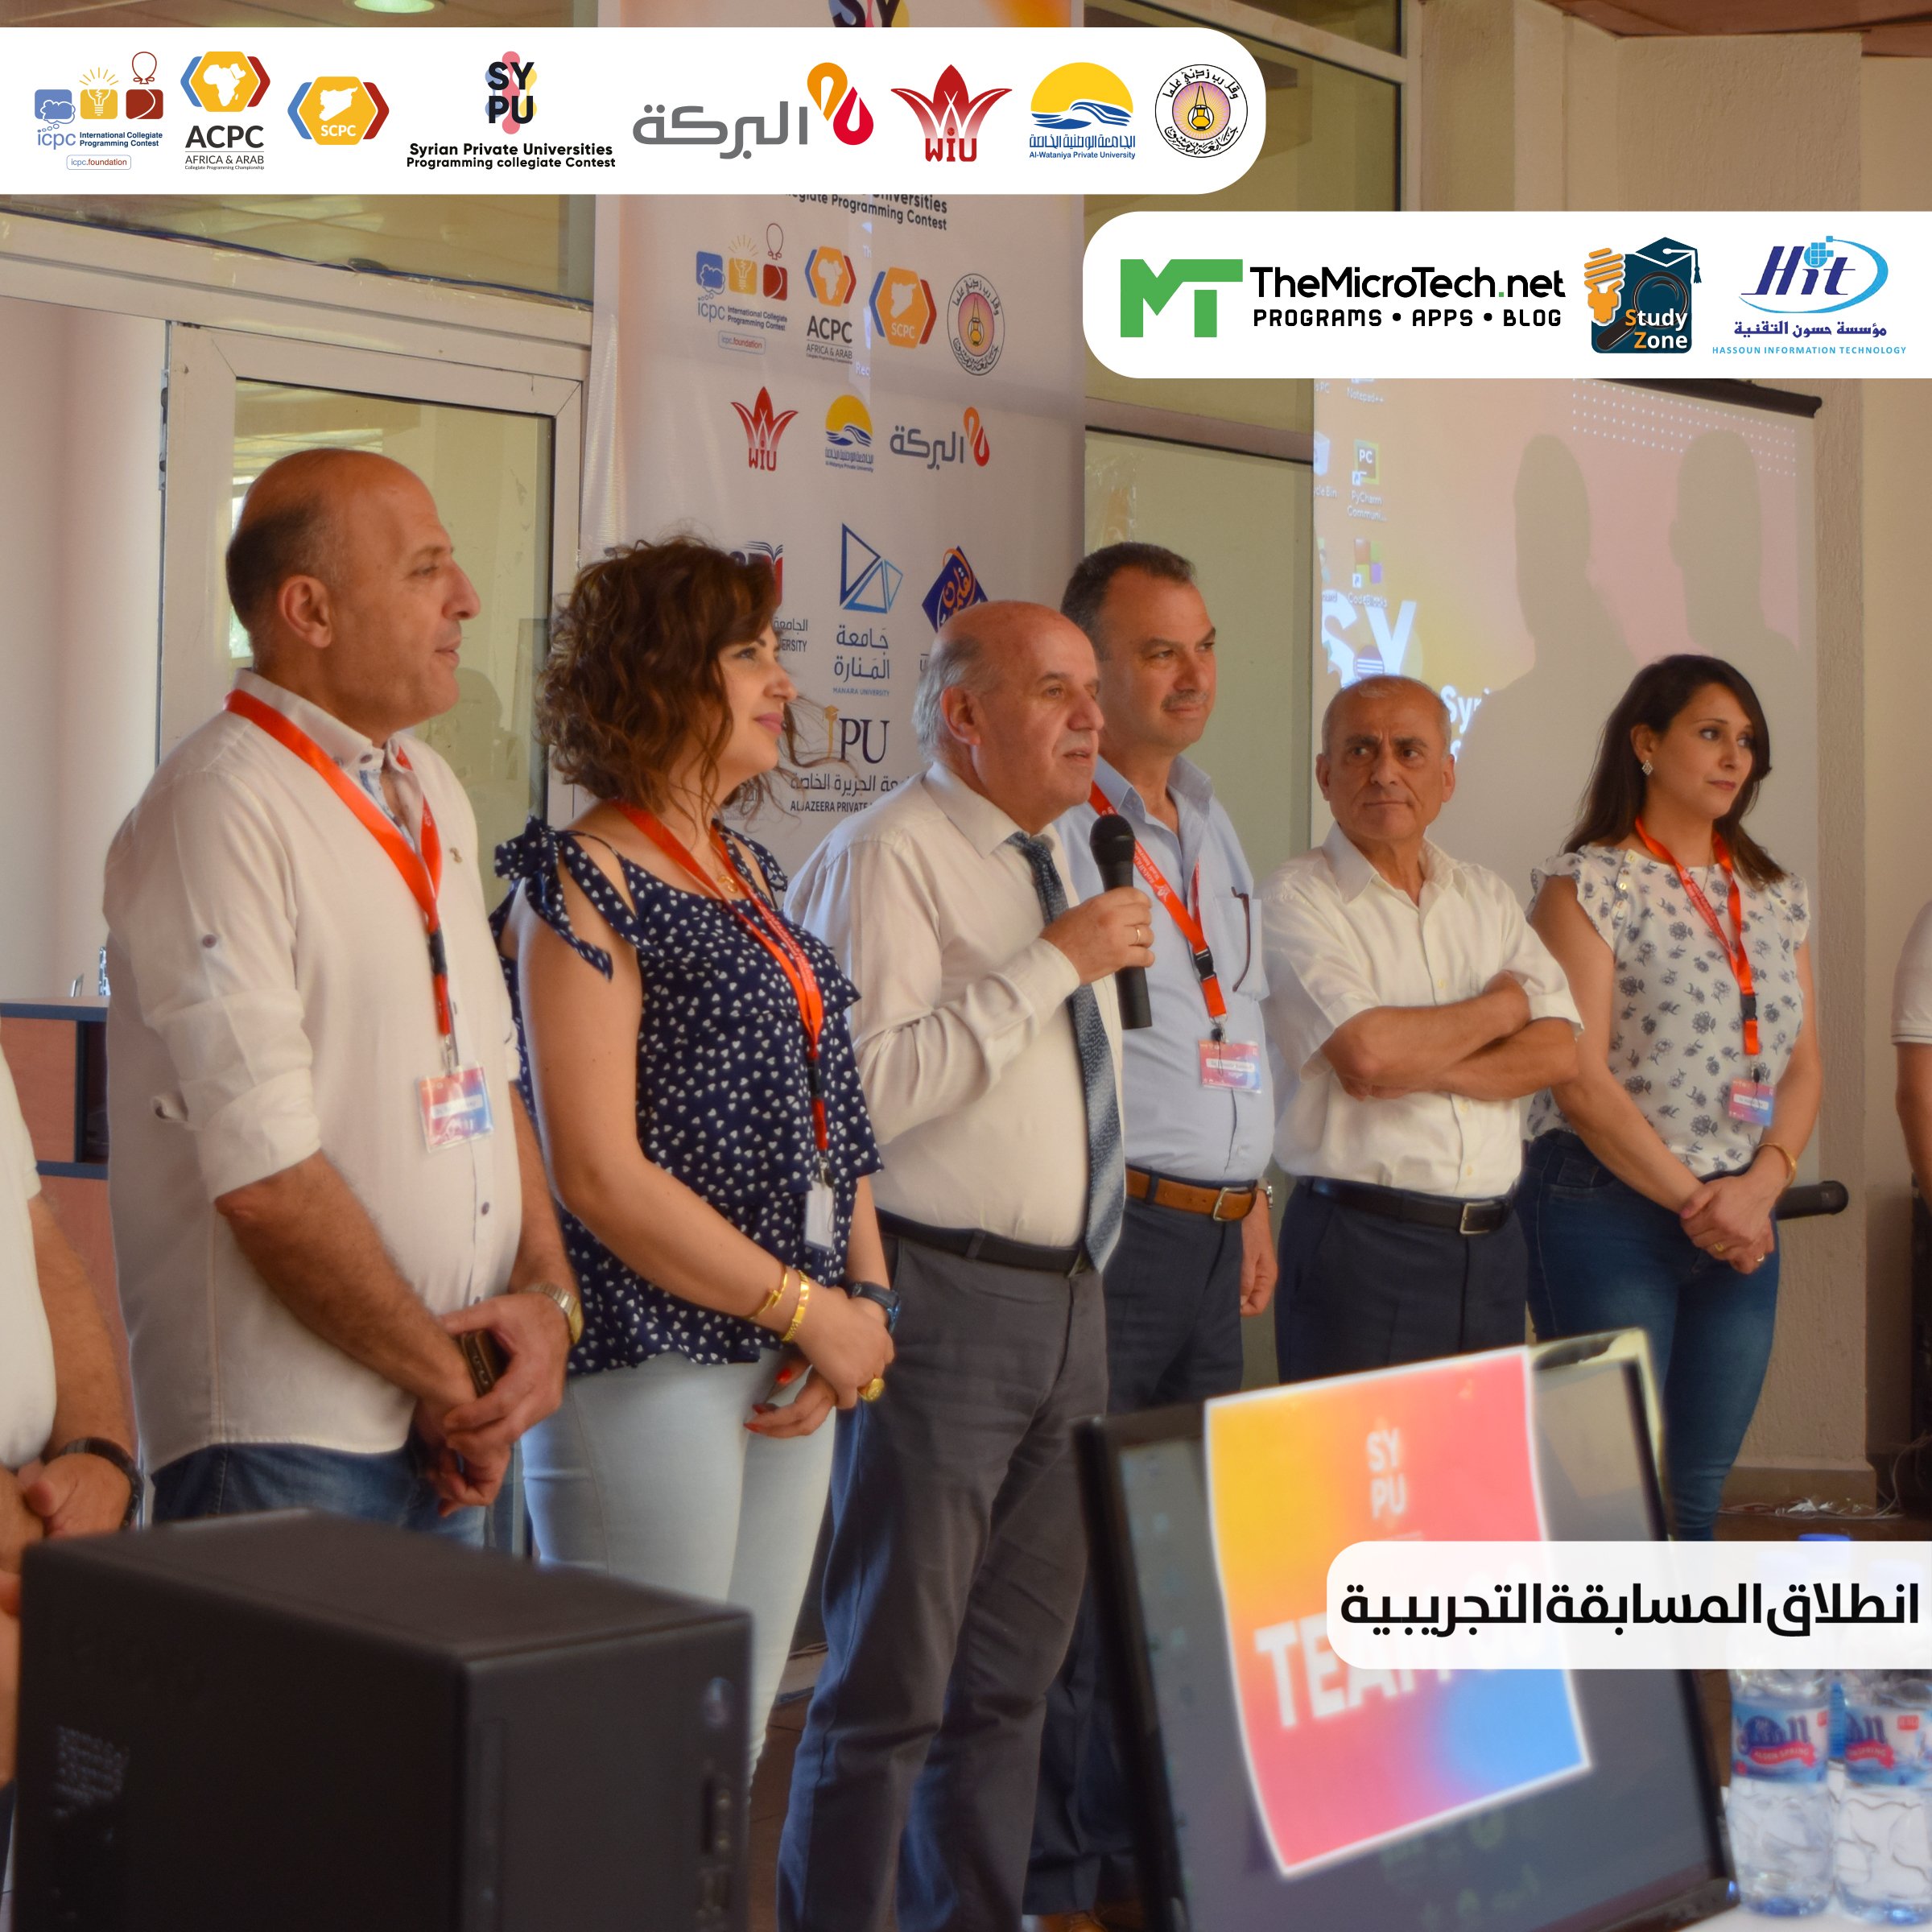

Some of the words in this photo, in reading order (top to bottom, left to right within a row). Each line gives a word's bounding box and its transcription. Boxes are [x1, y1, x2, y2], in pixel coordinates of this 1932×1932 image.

[831, 194, 903, 225] Programming
[906, 209, 947, 231] Contest
[727, 306, 763, 319] International
[763, 312, 788, 323] Collegiate
[727, 315, 765, 330] Programming
[765, 322, 786, 332] Contest
[807, 315, 853, 344] ACPC
[890, 322, 915, 340] SCPC
[806, 344, 829, 356] AFRICA
[835, 349, 853, 360] ARAB
[890, 425, 964, 470] البركة
[1359, 449, 1373, 464] PC
[749, 448, 777, 472] WIU
[1367, 1428, 1401, 1473] SY
[1371, 1474, 1406, 1521] PU
